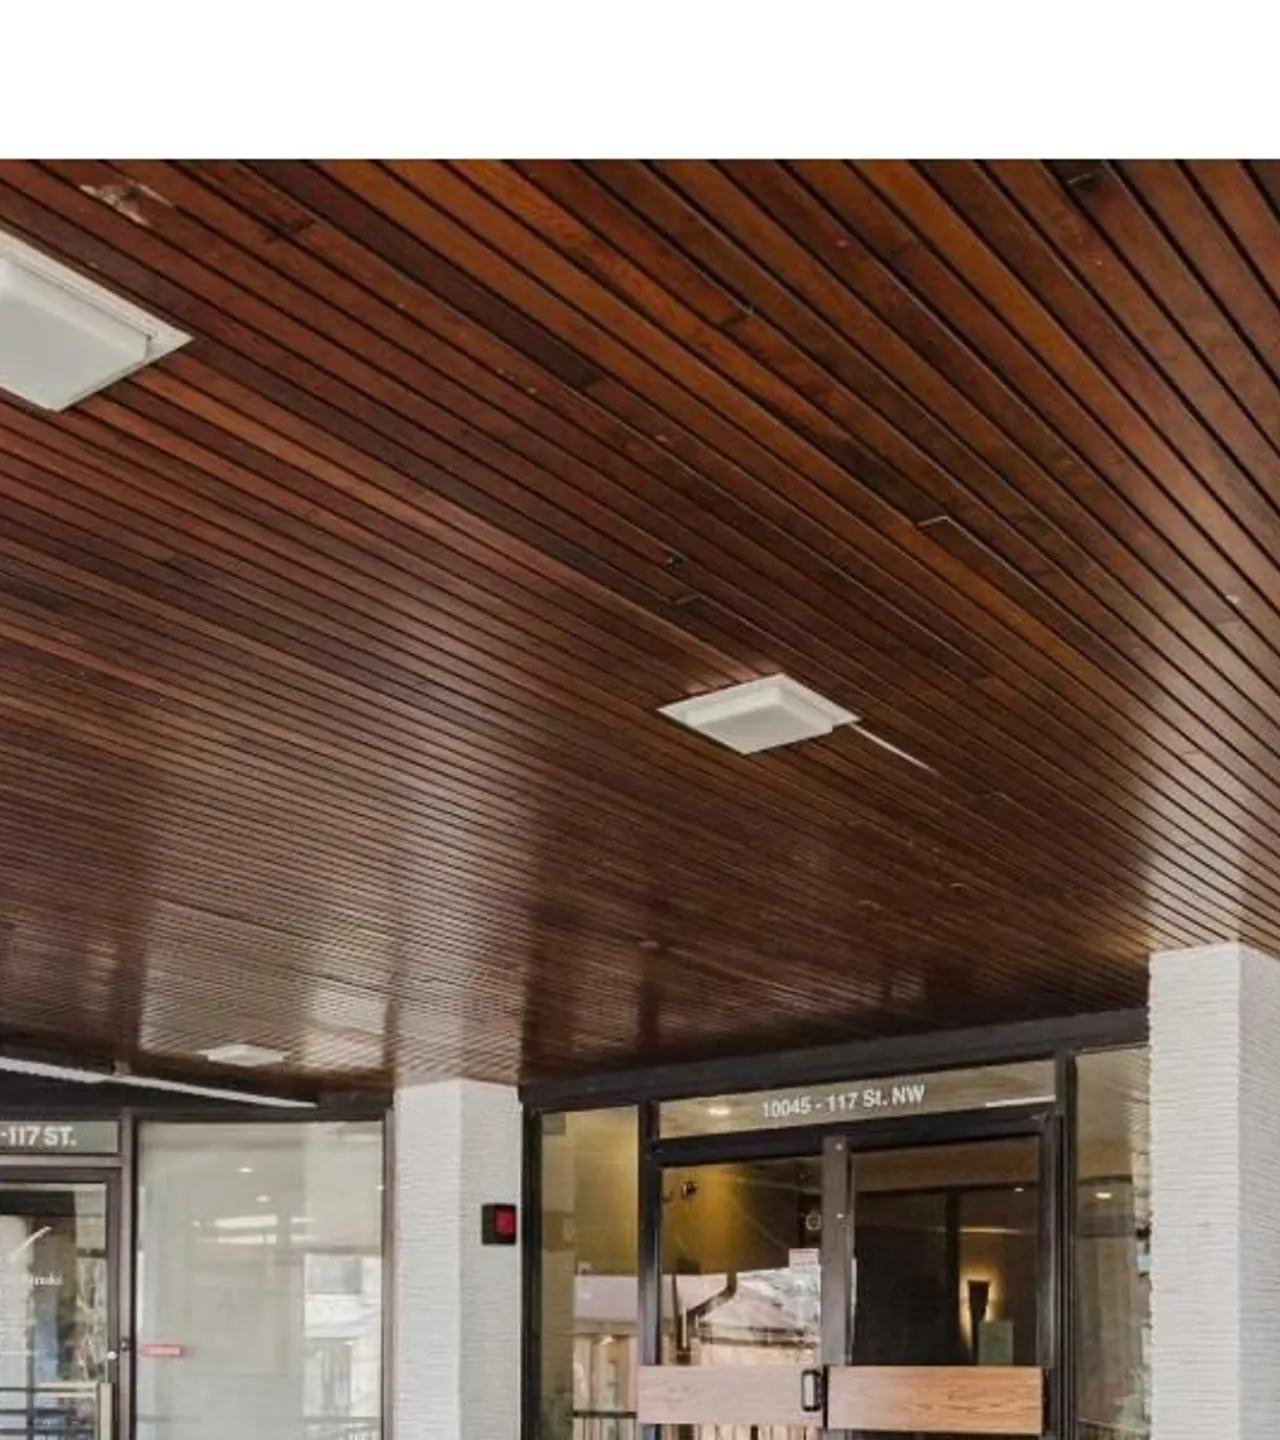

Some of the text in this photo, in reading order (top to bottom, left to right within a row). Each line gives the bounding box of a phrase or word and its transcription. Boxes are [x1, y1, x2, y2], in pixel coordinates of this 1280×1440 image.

[762, 1096, 812, 1118] 10045
[828, 1091, 859, 1112] 117
[891, 1084, 926, 1105] NW
[43, 1126, 77, 1147] ST.
